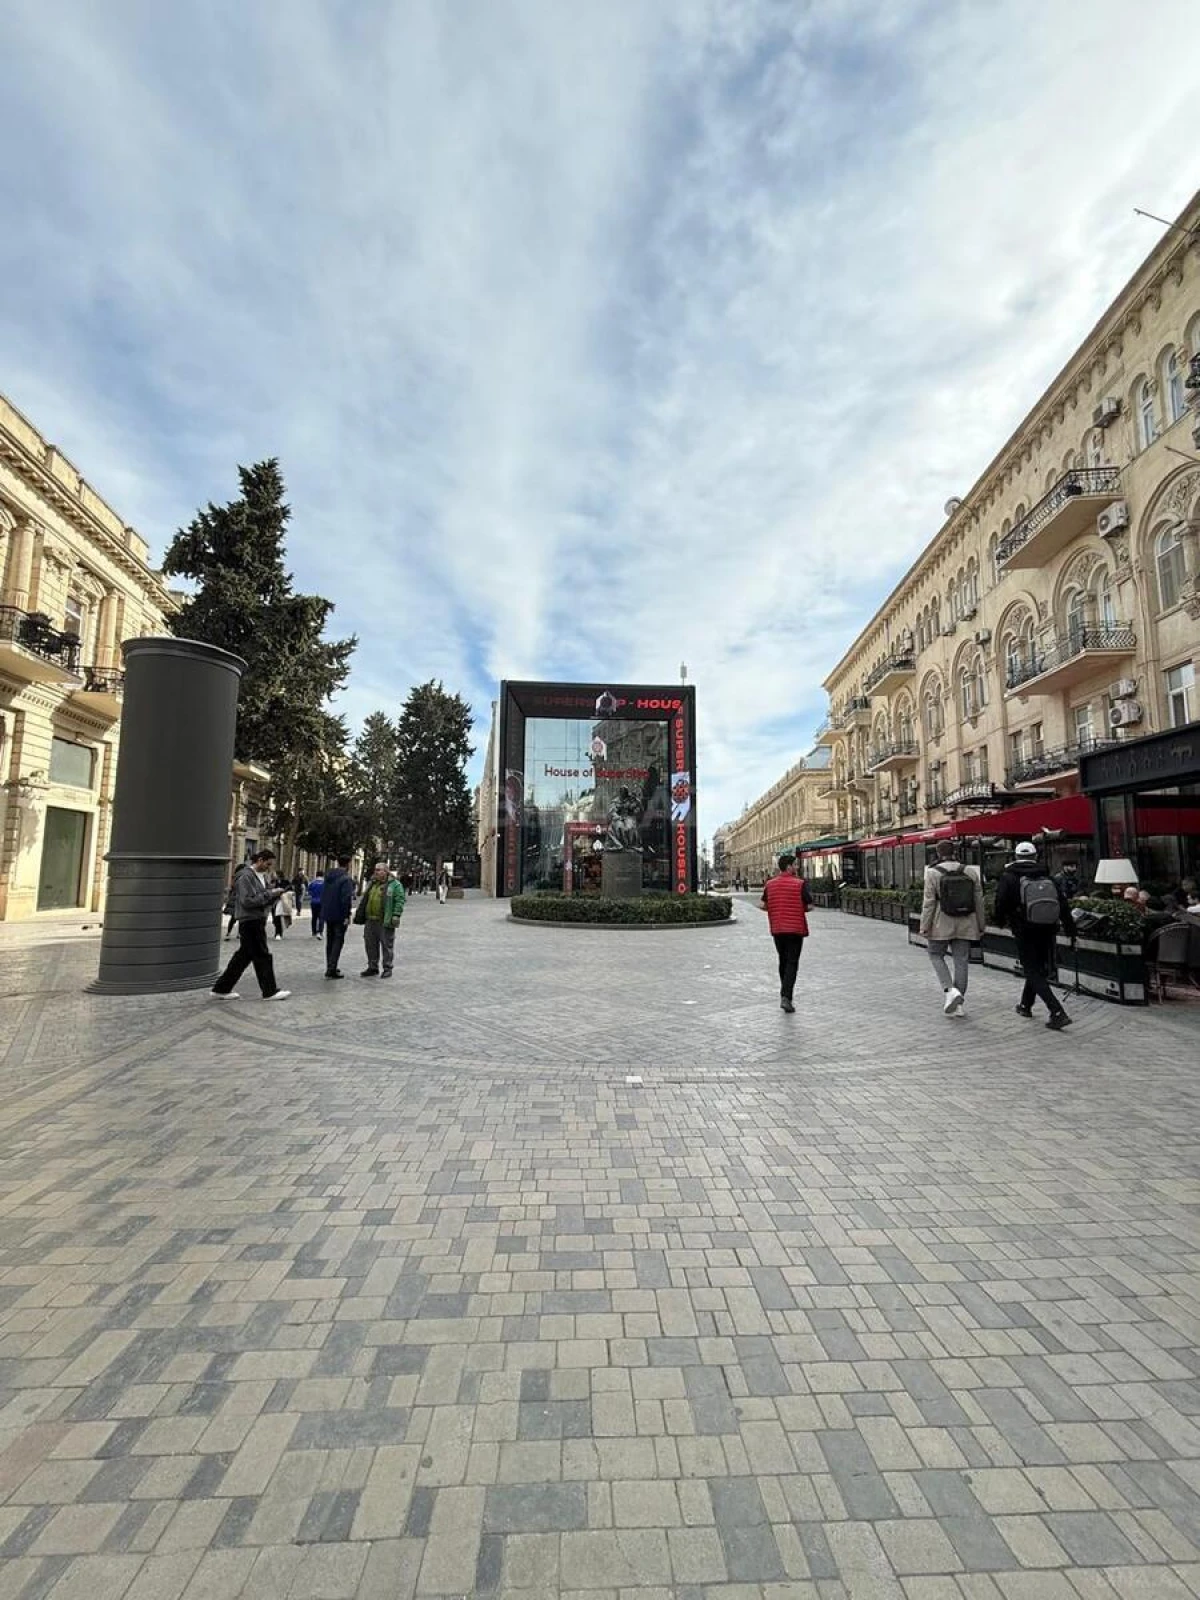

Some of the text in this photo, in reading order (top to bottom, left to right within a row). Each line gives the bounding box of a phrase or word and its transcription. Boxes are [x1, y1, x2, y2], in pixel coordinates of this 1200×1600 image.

[544, 764, 579, 777] House
[582, 766, 594, 777] of
[676, 822, 686, 880] HOUSE
